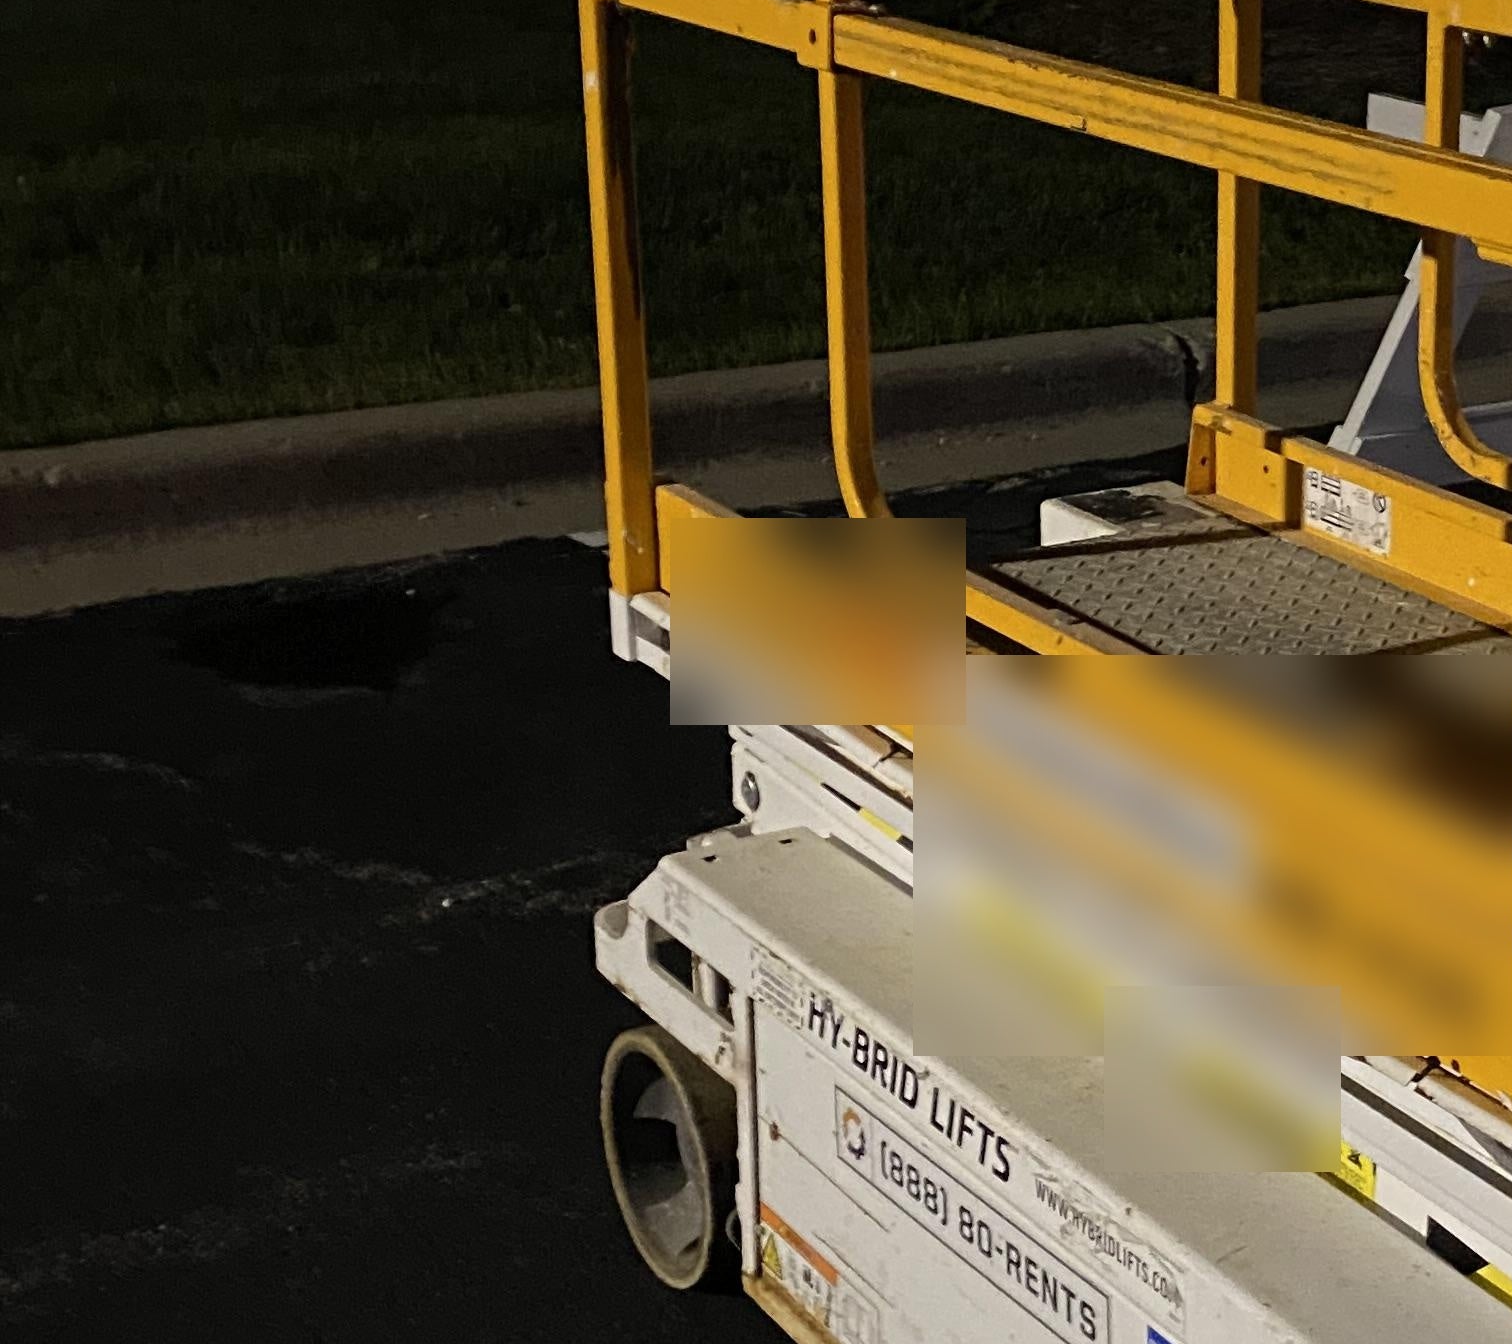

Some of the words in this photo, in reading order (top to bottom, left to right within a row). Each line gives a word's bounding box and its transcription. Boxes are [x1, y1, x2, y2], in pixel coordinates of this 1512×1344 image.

[806, 991, 920, 1110] HY-BRID
[930, 1086, 1012, 1183] LIFTS
[879, 1140, 949, 1227] (888)
[958, 1205, 1098, 1343] 80-RENTS
[1034, 1177, 1172, 1303] WWW.HYBRIDLIFTS.CO
